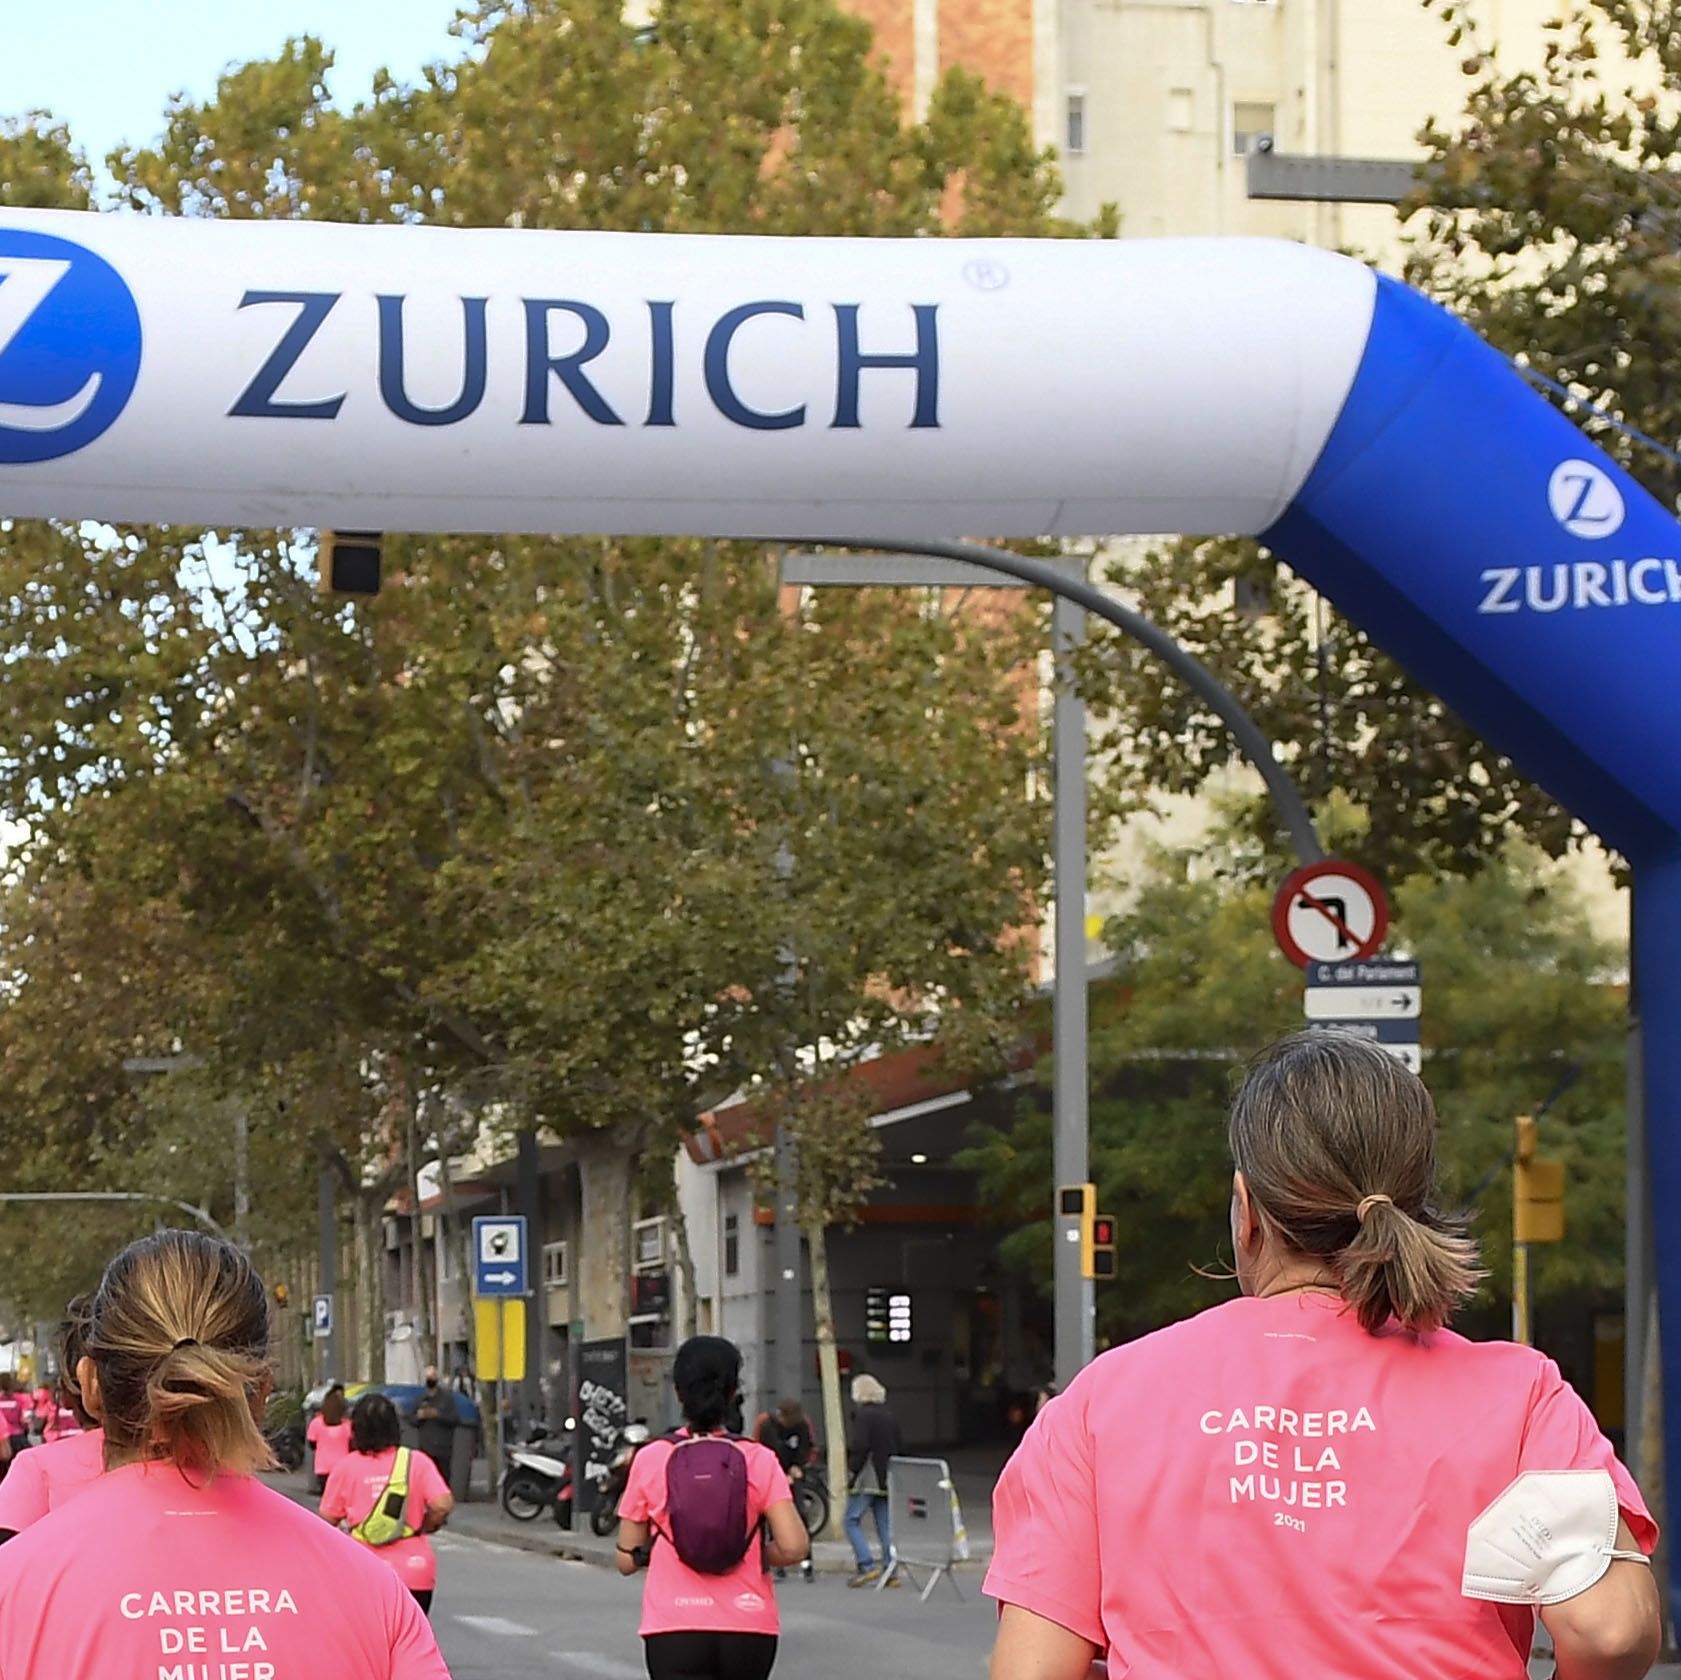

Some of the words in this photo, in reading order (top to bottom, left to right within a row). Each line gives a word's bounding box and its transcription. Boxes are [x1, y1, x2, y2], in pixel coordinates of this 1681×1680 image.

[225, 289, 942, 430] ZURICH
[1199, 1404, 1376, 1437] CARRERA
[1234, 1440, 1279, 1468] DE
[1294, 1446, 1341, 1472] LA
[1230, 1474, 1347, 1508] MUJER
[1273, 1512, 1306, 1532] 2021
[120, 1589, 298, 1619] CARRERA
[159, 1627, 208, 1654] DE
[220, 1626, 268, 1653] LA
